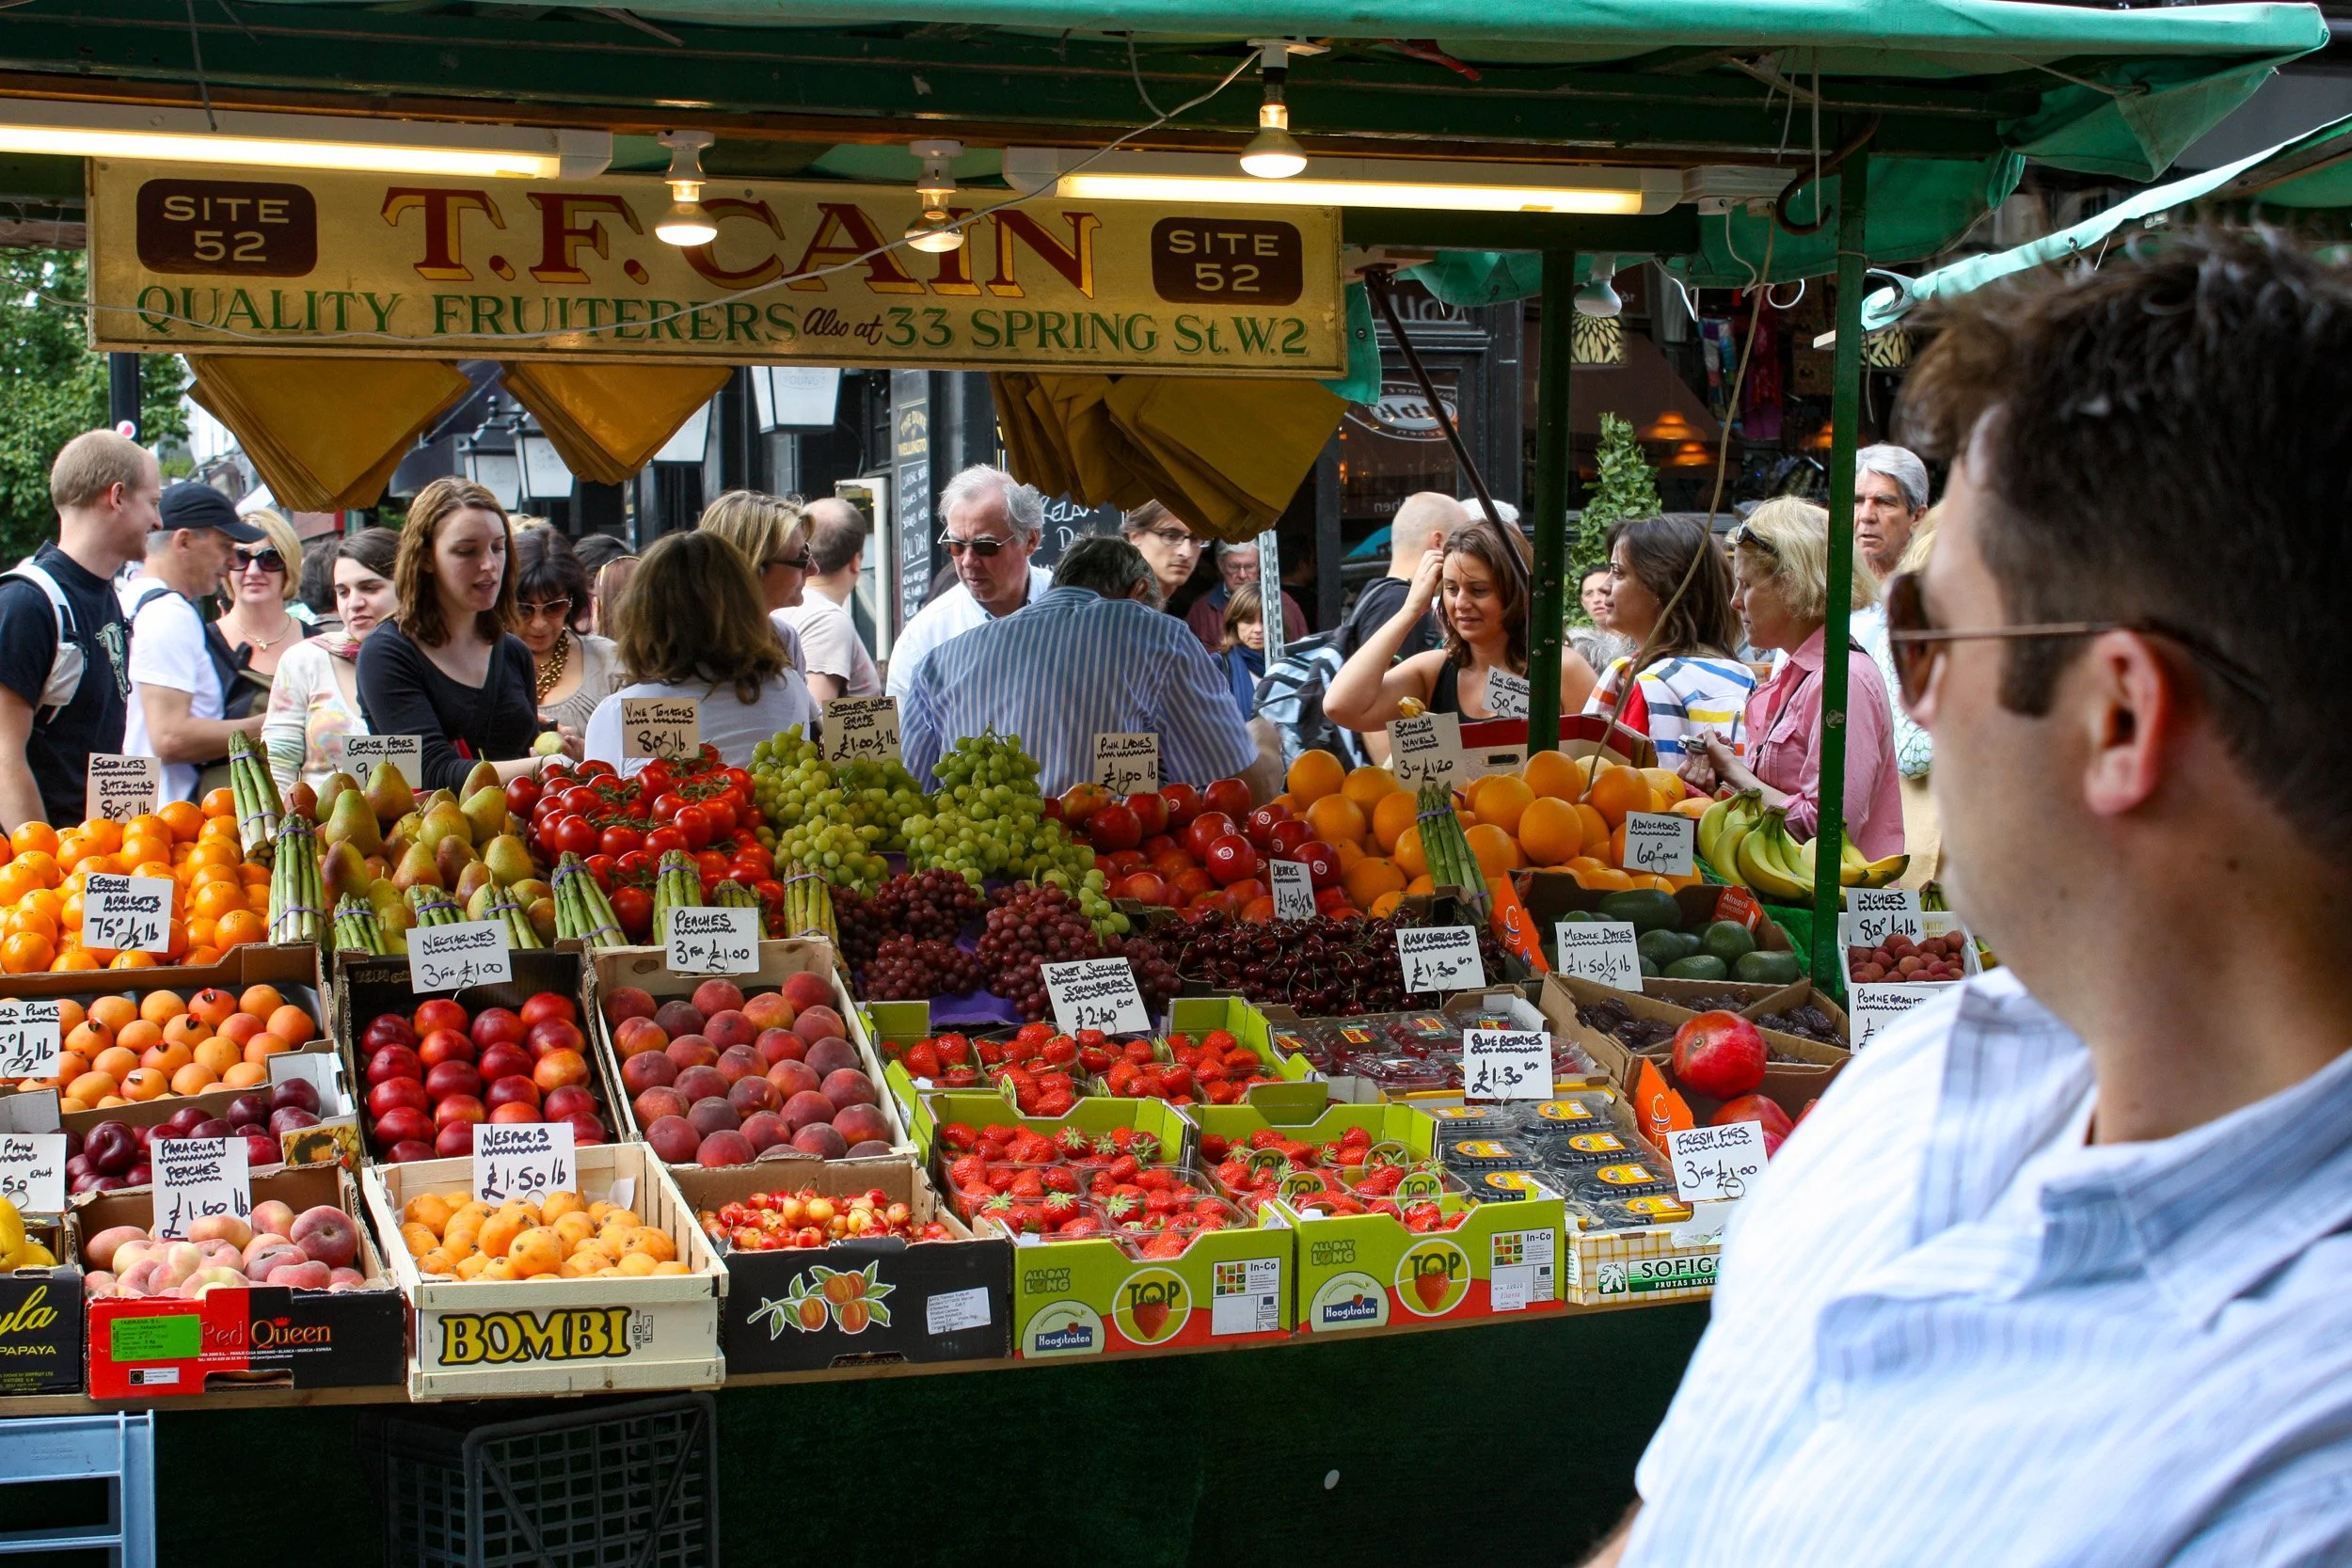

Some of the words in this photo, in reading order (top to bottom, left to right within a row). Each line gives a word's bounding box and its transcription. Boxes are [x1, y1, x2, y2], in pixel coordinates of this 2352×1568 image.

[163, 195, 290, 225] SITE
[194, 230, 267, 262] 52
[1168, 230, 1279, 257] SITE
[1195, 263, 1262, 293] 52
[135, 285, 401, 334] QUALITY
[433, 293, 798, 341] FRUITERERS
[803, 307, 849, 341] Also
[853, 309, 884, 345] at
[885, 307, 953, 347] 33
[971, 309, 1158, 353] SPRING
[1122, 737, 1152, 750] LADIES
[1400, 760, 1410, 780] 3
[1858, 893, 1905, 905] LYCHEES
[675, 910, 732, 928] PEACHES
[422, 928, 496, 949] NECTARINES
[1603, 928, 1633, 941] DATES
[675, 940, 688, 964] 3
[421, 963, 440, 987] 3
[26, 1003, 60, 1016] PLUMS
[4, 1138, 34, 1154] PAW
[162, 1137, 226, 1157] PARAGUAY
[1677, 1132, 1714, 1148] FRESH
[1718, 1127, 1749, 1140] FIGS
[166, 1162, 221, 1181] PEACHES
[482, 1162, 546, 1200] £1.50
[551, 1157, 566, 1184] lb
[1683, 1161, 1700, 1188] 3
[1405, 1180, 1437, 1196] TOP
[163, 1193, 228, 1238] £1.60
[1526, 1232, 1551, 1242] In-Co
[1250, 1262, 1276, 1272] In-Co
[1410, 1252, 1461, 1280] TOP
[1656, 1279, 1688, 1289] FRUTAS
[1128, 1281, 1180, 1309] TOP
[251, 1320, 331, 1349] Queen
[438, 1307, 632, 1366] BOMBI
